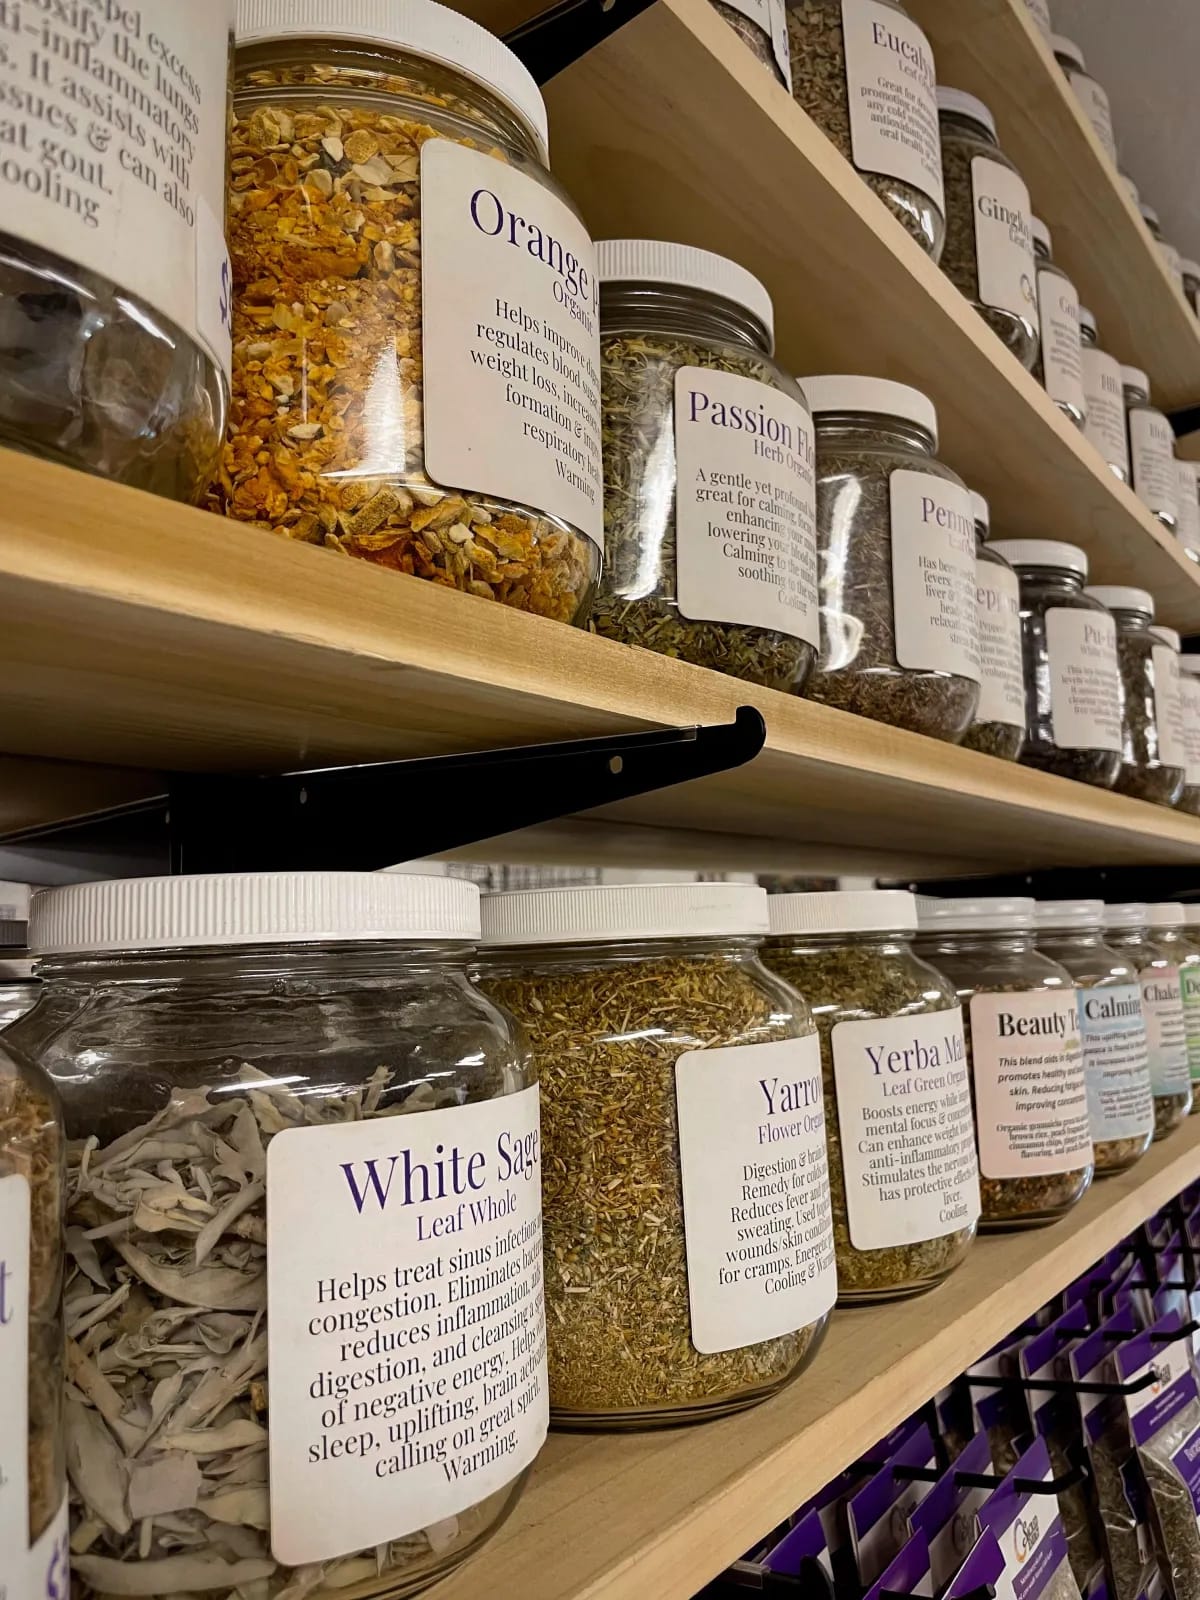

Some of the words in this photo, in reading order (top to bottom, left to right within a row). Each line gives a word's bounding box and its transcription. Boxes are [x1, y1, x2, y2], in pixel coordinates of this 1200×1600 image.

[113, 33, 151, 81] the
[155, 65, 200, 135] lungs
[147, 31, 201, 105] excess
[30, 51, 54, 88] It
[61, 76, 147, 148] assists
[152, 136, 190, 191] with
[40, 138, 113, 196] gout.
[87, 120, 111, 153] &
[118, 148, 157, 192] can
[163, 182, 194, 228] also
[470, 189, 588, 300] Orange
[495, 298, 540, 334] Helps
[544, 320, 586, 368] improve
[476, 323, 549, 365] regulates
[552, 351, 580, 388] blood
[470, 349, 529, 382] weight
[532, 366, 561, 400] loss,
[505, 383, 572, 432] formation
[574, 420, 583, 438] &
[688, 391, 792, 449] Passion
[523, 421, 586, 471] respiratory
[754, 439, 784, 465] Herb
[695, 467, 706, 482] A
[710, 471, 752, 489] gentle
[755, 480, 772, 495] yet
[695, 488, 733, 504] great
[737, 491, 756, 508] for
[759, 498, 797, 526] calming
[708, 521, 765, 549] lowering
[723, 542, 775, 568] Calming
[738, 566, 786, 592] soothing
[997, 1011, 1066, 1038] Beauty
[864, 1039, 941, 1075] Yerba
[998, 1056, 1018, 1068] This
[1019, 1055, 1043, 1067] blend
[882, 1078, 911, 1097] Leaf
[914, 1075, 946, 1093] Green
[997, 1071, 1041, 1084] promotes
[1009, 1085, 1030, 1096] skin.
[1032, 1082, 1064, 1095] Reducing
[862, 1105, 903, 1121] Boosts
[905, 1099, 939, 1116] energy
[1015, 1099, 1056, 1112] improving
[757, 1122, 802, 1145] Flower
[858, 1139, 884, 1153] Can
[887, 1134, 933, 1150] enhance
[865, 1118, 908, 1137] mental
[910, 1116, 937, 1131] focus
[339, 1143, 486, 1215] White
[497, 1128, 539, 1181] Sage
[743, 1157, 797, 1182] Digestion
[868, 1142, 960, 1169] anti-inflammatory
[742, 1176, 790, 1201] Remedy
[792, 1172, 806, 1189] for
[861, 1167, 926, 1187] Stimulates
[927, 1161, 943, 1178] the
[879, 1187, 901, 1202] has
[903, 1176, 953, 1201] protective
[416, 1203, 466, 1242] Leaf
[469, 1188, 518, 1227] Whole
[731, 1200, 784, 1223] Reduces
[786, 1191, 809, 1210] fever
[737, 1215, 795, 1242] sweating.
[796, 1203, 816, 1226] Used
[317, 1272, 387, 1303] Helps
[394, 1255, 444, 1288] treat
[449, 1242, 492, 1274] sinus
[495, 1219, 537, 1258] infections
[725, 1231, 803, 1263] wounds/skin
[719, 1267, 741, 1285] for
[744, 1257, 793, 1280] cramps.
[765, 1270, 807, 1295] Cooling
[308, 1291, 442, 1336] congestion.
[448, 1257, 521, 1304] Eliminates
[340, 1321, 431, 1362] reduces
[437, 1280, 531, 1337] inflammation,
[309, 1354, 426, 1400] digestion,
[433, 1335, 468, 1367] and
[471, 1306, 528, 1353] cleansing
[321, 1398, 348, 1428] of
[353, 1379, 448, 1421] negative
[453, 1350, 509, 1390] energy.
[512, 1327, 536, 1361] Helps
[308, 1430, 381, 1463] sleep,
[388, 1396, 480, 1444] uplifting,
[482, 1370, 518, 1406] brain
[376, 1439, 447, 1479] calling
[453, 1426, 475, 1450] on
[479, 1405, 515, 1441] great
[517, 1375, 541, 1416] spirit.
[443, 1428, 519, 1483] Warming.
